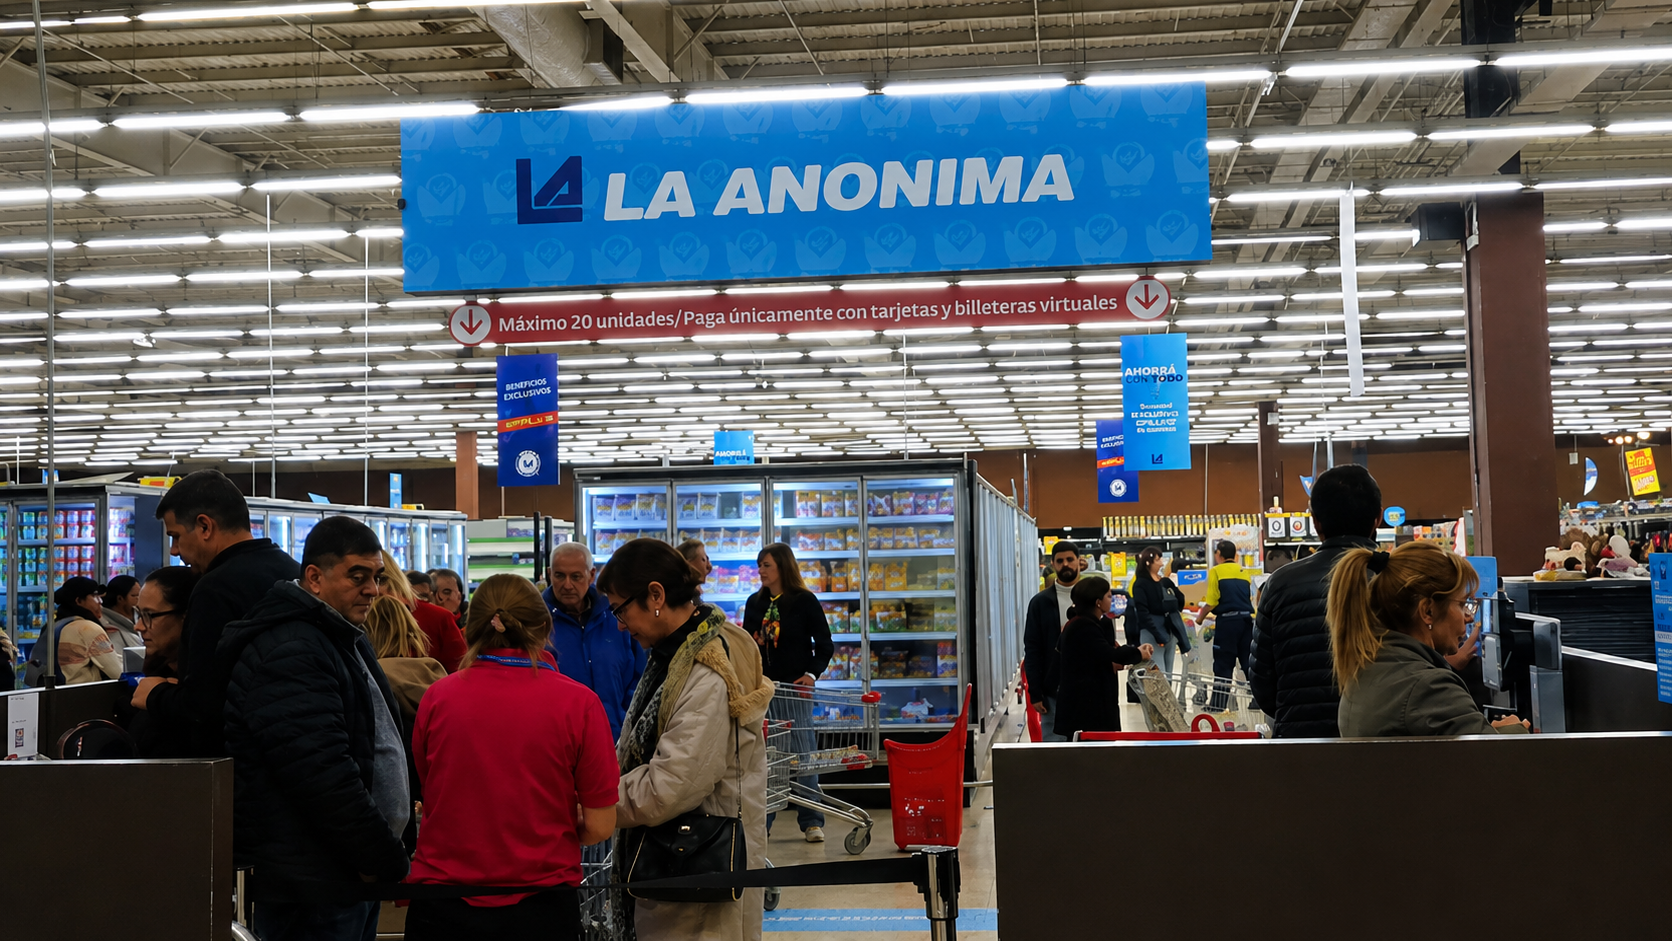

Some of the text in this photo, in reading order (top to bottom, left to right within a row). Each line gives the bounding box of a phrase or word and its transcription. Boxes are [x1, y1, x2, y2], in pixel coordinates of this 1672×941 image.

[604, 154, 1075, 221] LA ANONIMA
[499, 315, 567, 332] Máximo
[570, 314, 593, 330] 20
[729, 307, 833, 323] únicamente
[837, 305, 867, 320] con
[870, 302, 938, 322] tarjetas
[941, 302, 952, 320] y
[955, 299, 1036, 316] billeteras
[1039, 295, 1118, 312] virtuales
[1124, 363, 1176, 376] AHORRÁ
[1125, 374, 1184, 384] CON TODO
[503, 386, 552, 401] EXCLUSIVOS
